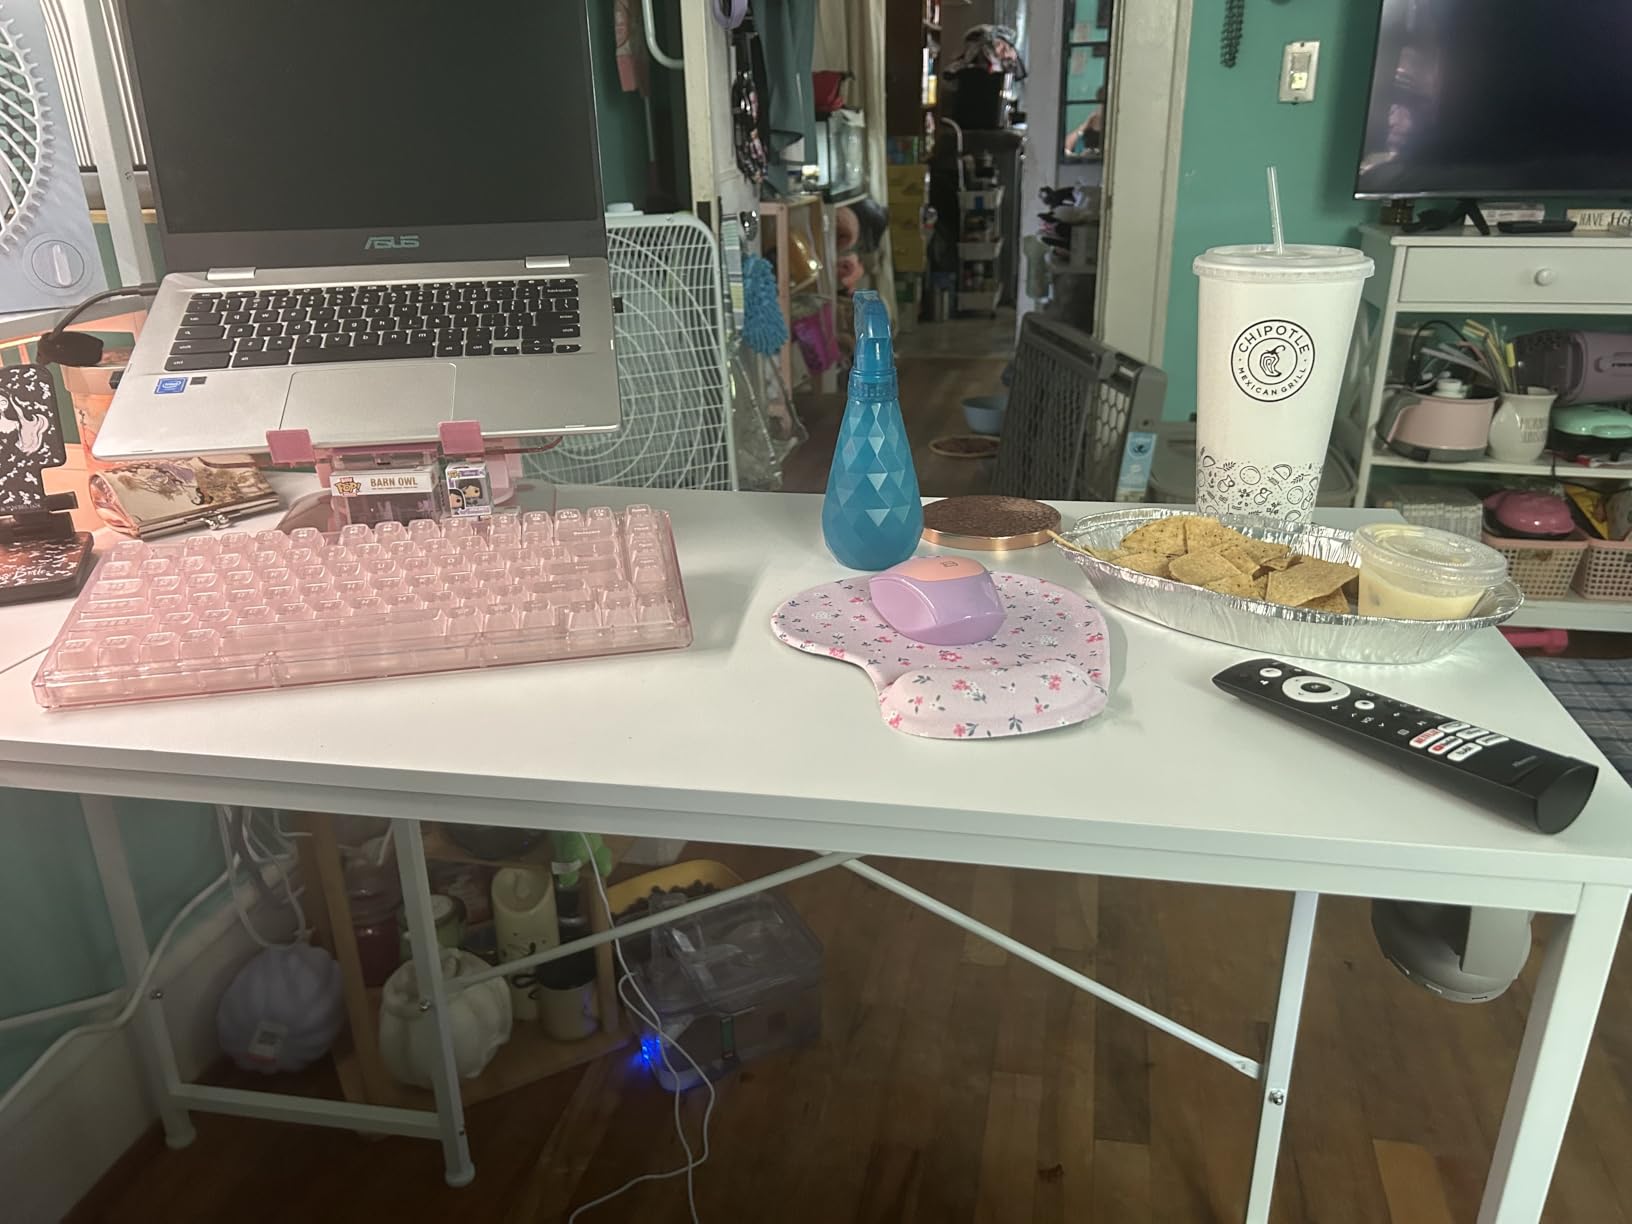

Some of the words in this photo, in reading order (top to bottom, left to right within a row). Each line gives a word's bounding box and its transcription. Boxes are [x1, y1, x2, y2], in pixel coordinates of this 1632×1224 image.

[1579, 212, 1604, 226] HAVE
[364, 234, 420, 250] ASUS
[1238, 325, 1310, 355] CHIPOTLE
[1238, 367, 1278, 395] MEXICAN
[1281, 367, 1307, 393] GRILL
[370, 477, 396, 487] BARN
[398, 476, 418, 486] OWL
